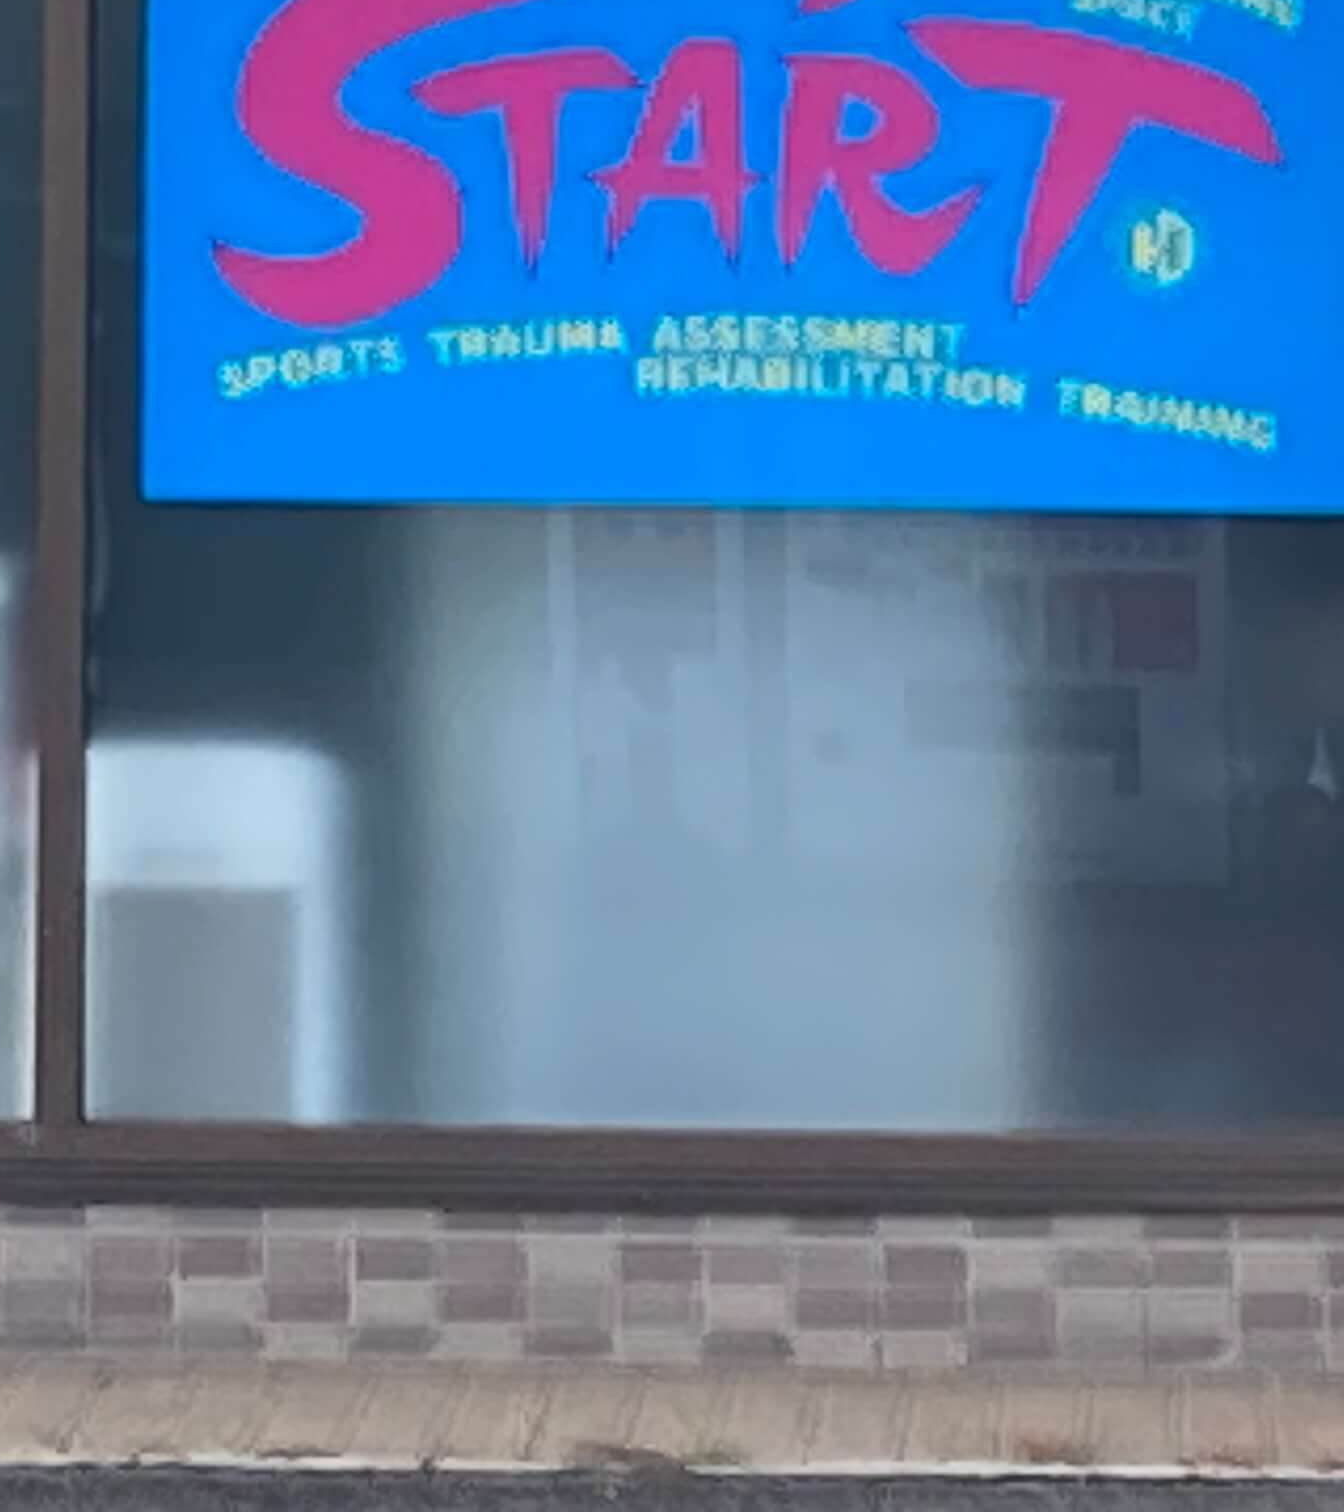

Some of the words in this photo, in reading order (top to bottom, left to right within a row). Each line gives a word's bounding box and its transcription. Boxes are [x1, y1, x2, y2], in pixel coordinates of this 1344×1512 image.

[217, 333, 405, 399] SPORTS
[427, 317, 627, 367] TRAUMA
[651, 314, 965, 360] ASSESSMENT
[635, 354, 1029, 410] REHABILITATION
